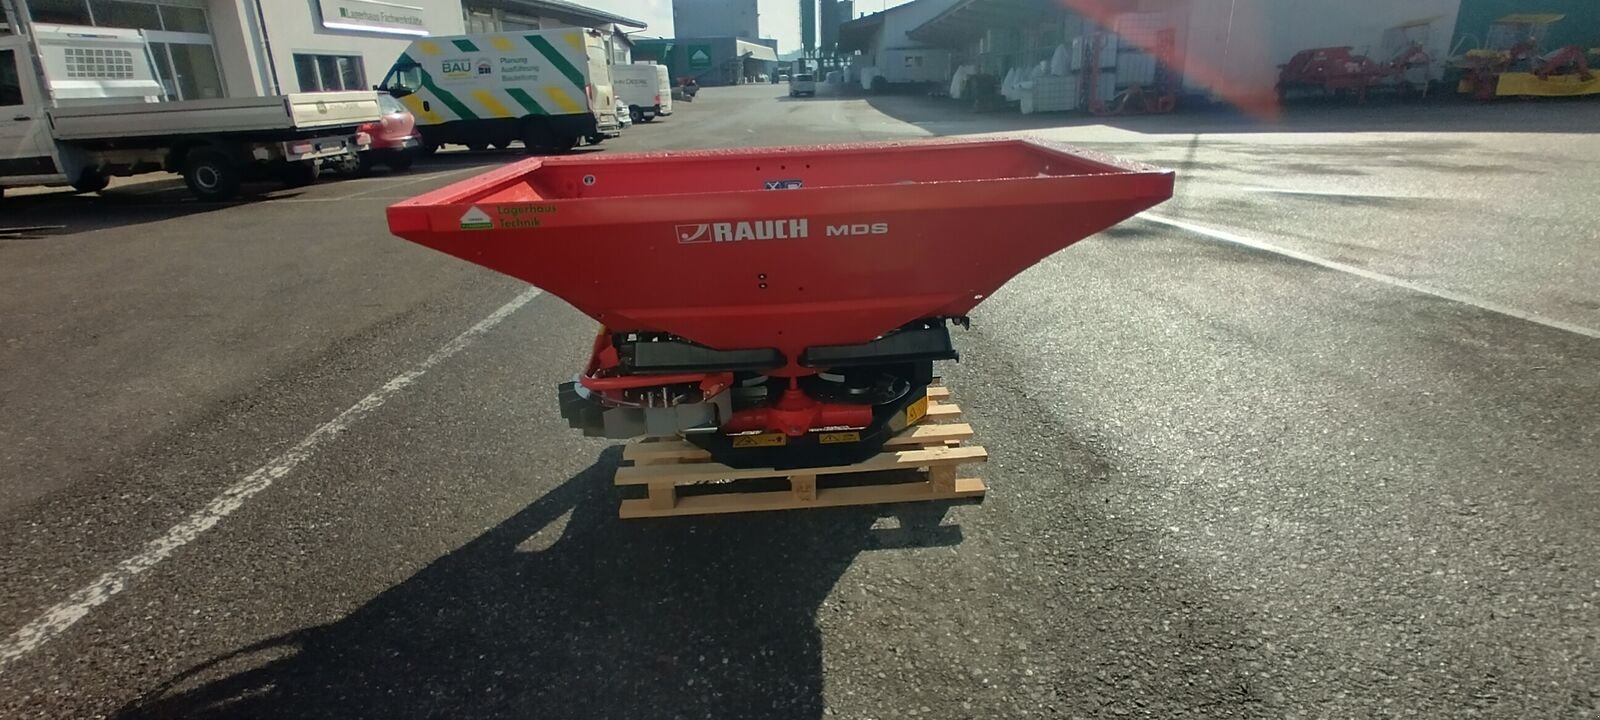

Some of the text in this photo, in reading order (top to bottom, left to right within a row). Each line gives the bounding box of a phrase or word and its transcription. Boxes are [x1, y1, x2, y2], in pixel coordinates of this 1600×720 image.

[442, 62, 472, 73] BAU
[497, 203, 558, 215] Lagerhaus
[499, 217, 540, 229] Technik
[713, 218, 889, 242] RAUCH MDS
